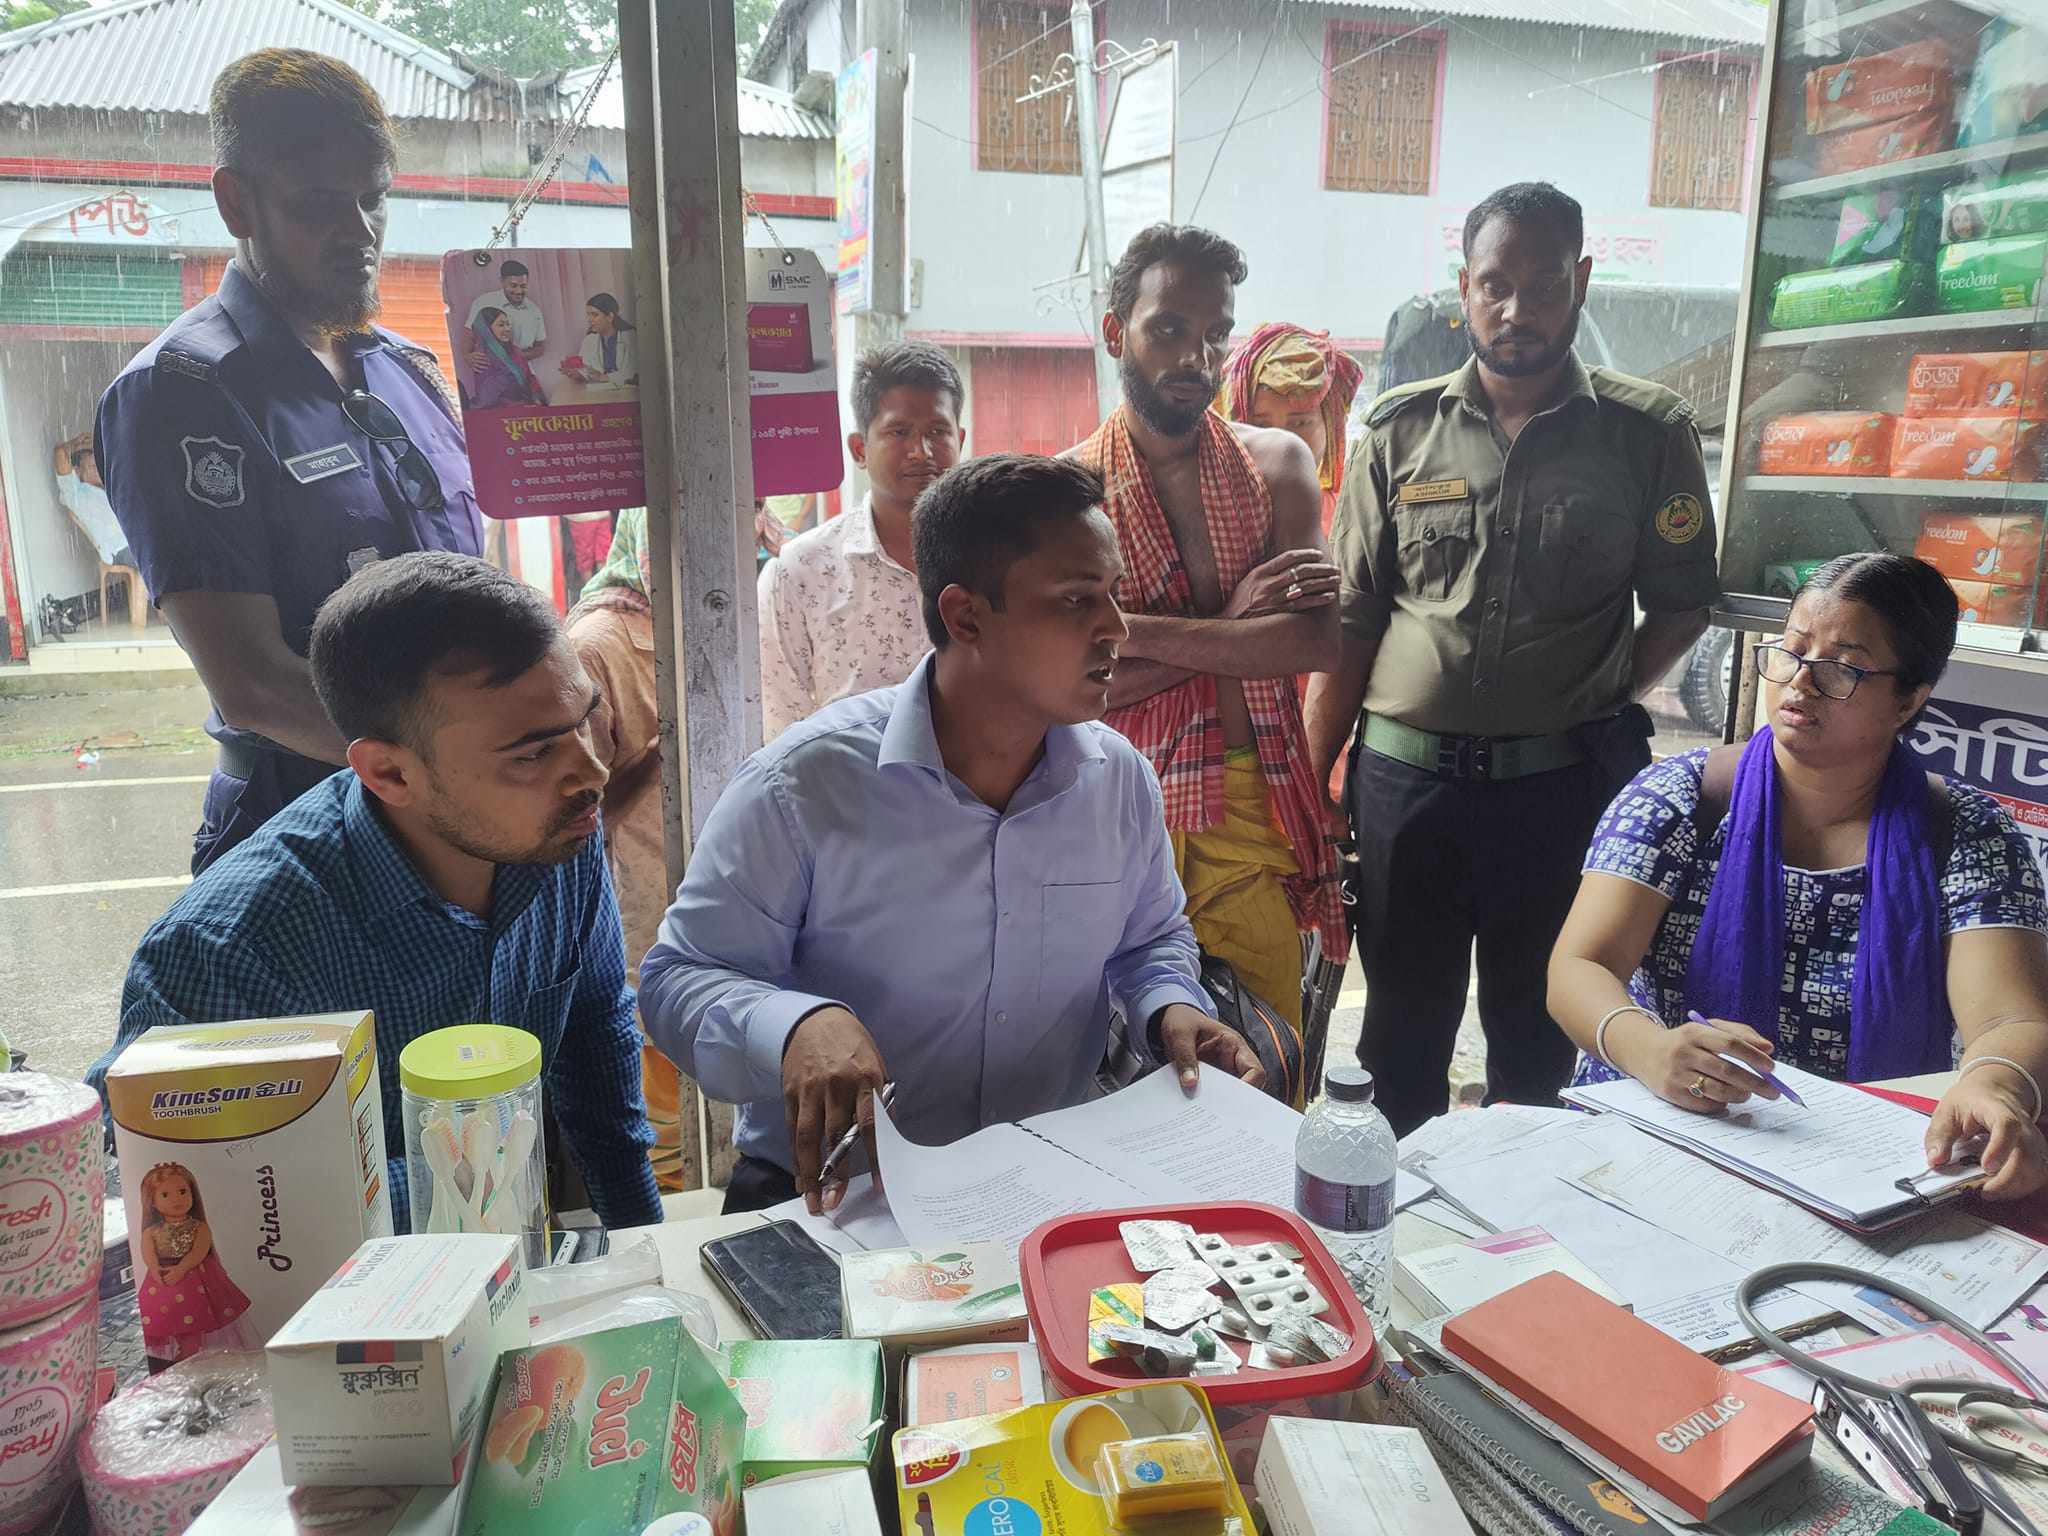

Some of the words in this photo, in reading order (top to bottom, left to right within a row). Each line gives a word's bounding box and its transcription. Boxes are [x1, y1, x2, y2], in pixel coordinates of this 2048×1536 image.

[785, 275, 811, 285] SMC
[1939, 271, 1999, 296] freedom
[1901, 423, 1956, 448] freedom
[152, 1086, 251, 1109] KingSon
[254, 1079, 303, 1098] 金山
[153, 1105, 222, 1120] TOOTHBRUSH
[0, 1194, 52, 1227] resh
[256, 1164, 291, 1272] Princess
[18, 1226, 51, 1241] Tissue
[931, 1260, 976, 1286] Diet
[489, 1266, 522, 1326] Flucloxin
[338, 1364, 419, 1395] ফ্লুক্লক্সিন
[11, 1395, 43, 1422] Gold
[589, 1366, 652, 1470] Juci
[1656, 1395, 1745, 1453] GAVILAC
[984, 1458, 1014, 1536] EROCAL
